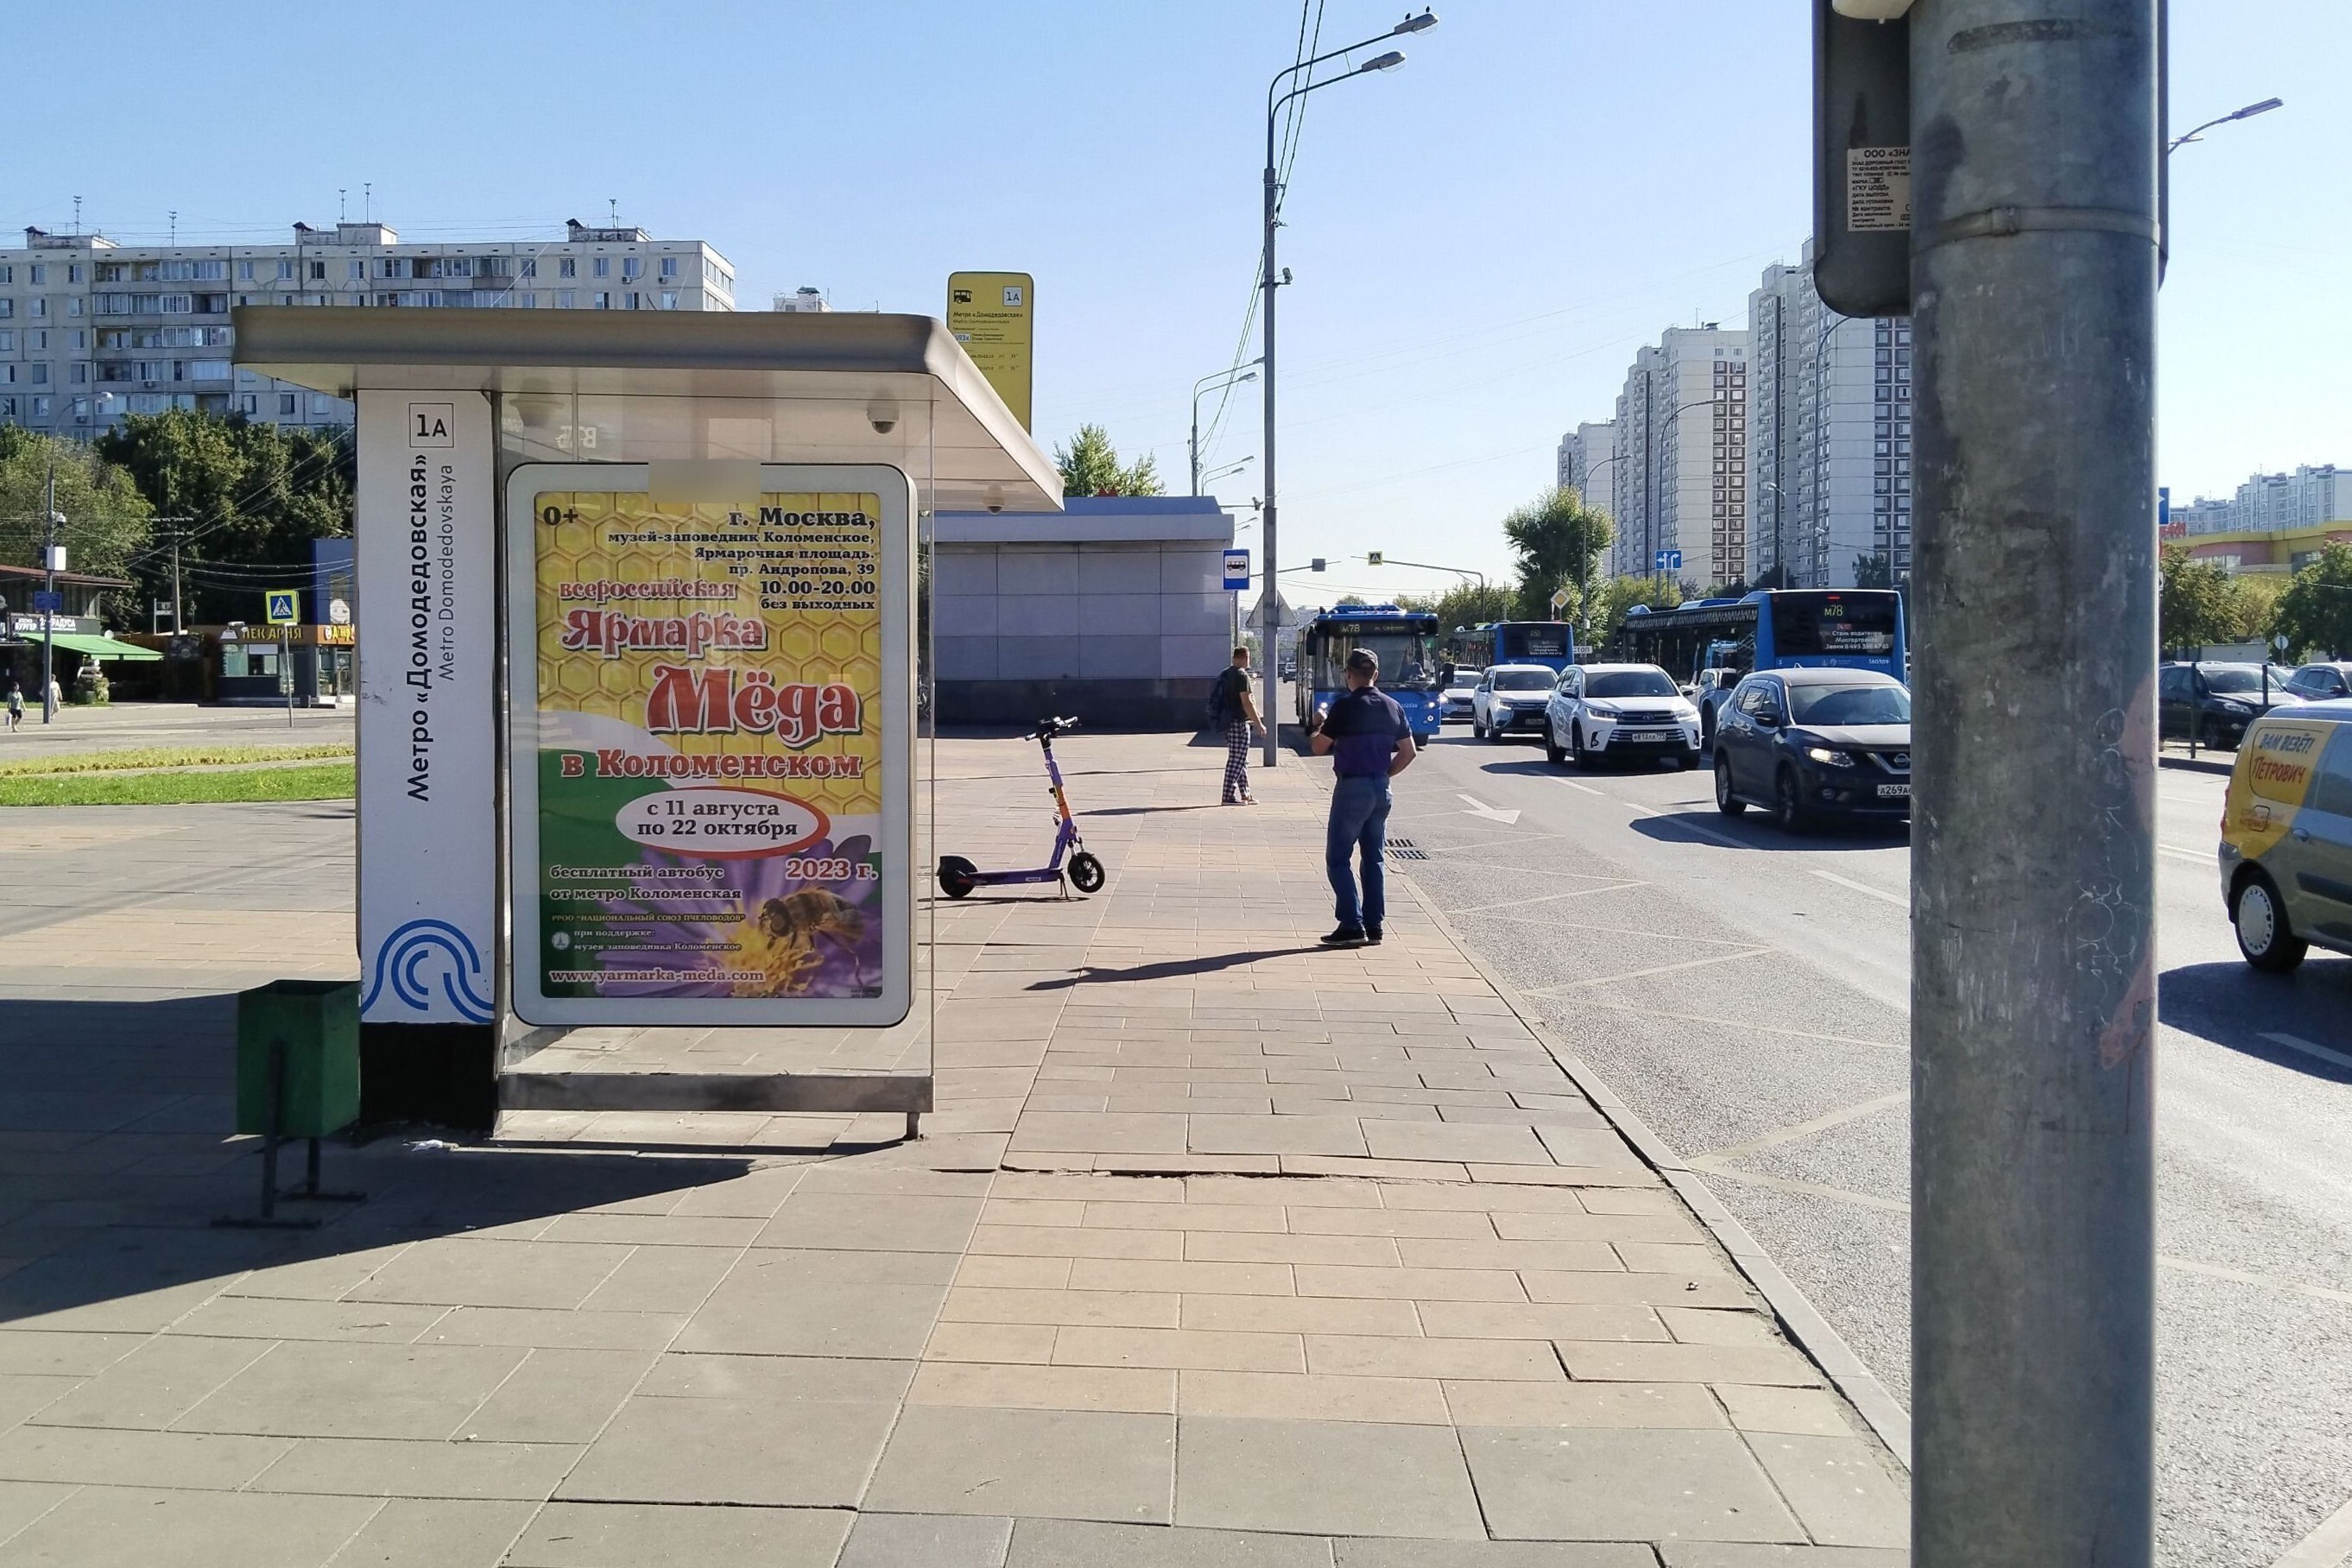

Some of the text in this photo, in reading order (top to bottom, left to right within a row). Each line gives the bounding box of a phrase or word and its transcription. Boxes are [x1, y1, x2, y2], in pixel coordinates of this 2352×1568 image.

[544, 506, 579, 526] 0+
[729, 507, 876, 529] г. Москва,
[608, 531, 875, 545] музей-заповедник Коломенское,
[694, 547, 793, 560] Ярмарочная
[437, 465, 457, 681] Metro Domodedovskaya
[729, 564, 876, 578] пр. Андропова, 39
[560, 579, 736, 602] всероссийская
[760, 580, 876, 594] 10.00-20.00
[761, 597, 876, 610] без выходных
[407, 454, 433, 802] Метро «Домодедовская»
[562, 609, 764, 656] Ярмарка
[647, 665, 860, 744] Мёда
[562, 749, 862, 776] в Коломенском
[648, 800, 780, 819] с 11 августа
[637, 819, 798, 840] по 22 октября
[551, 865, 724, 880] бесплатный автобус
[787, 860, 878, 879] 2023 г.
[551, 888, 741, 902] от метро Коломенская
[550, 968, 764, 986] www.yarmarka-meda.com
